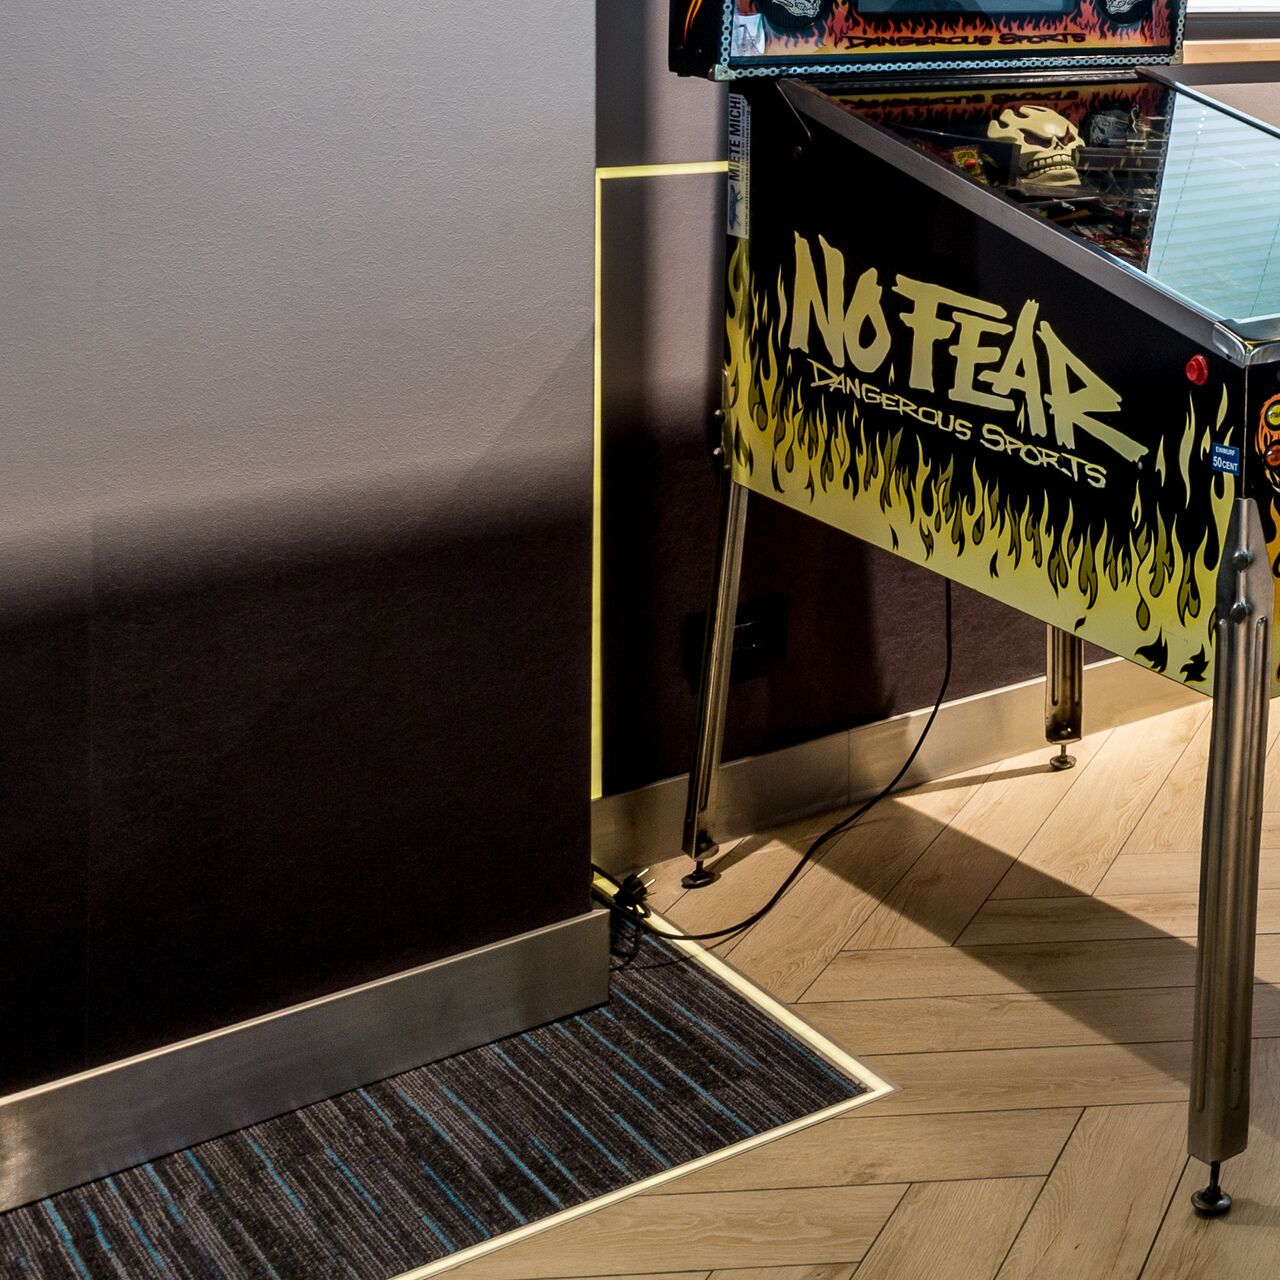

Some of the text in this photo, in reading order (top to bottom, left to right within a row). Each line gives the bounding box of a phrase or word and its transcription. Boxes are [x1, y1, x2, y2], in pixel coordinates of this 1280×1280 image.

[844, 35, 993, 50] DANGEROUS
[729, 96, 741, 182] MIETE MICH!
[789, 230, 1149, 462] NO FEAR
[807, 358, 1107, 488] DANGEROUS SPORTS
